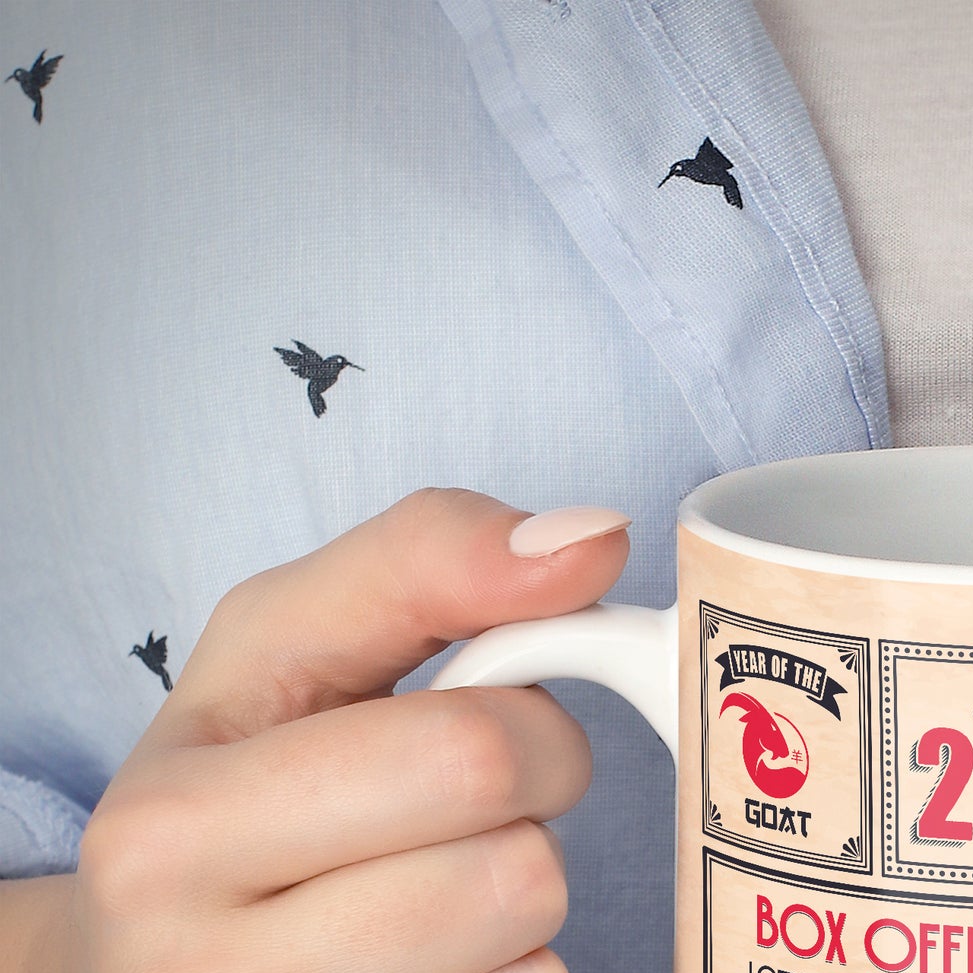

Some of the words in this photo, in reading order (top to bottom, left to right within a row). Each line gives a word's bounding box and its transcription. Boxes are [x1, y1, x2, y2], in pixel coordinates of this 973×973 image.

[733, 650, 767, 675] YEAR
[771, 655, 789, 680] OF
[794, 663, 823, 693] THE
[745, 798, 811, 838] GOAT
[756, 894, 847, 966] BOX
